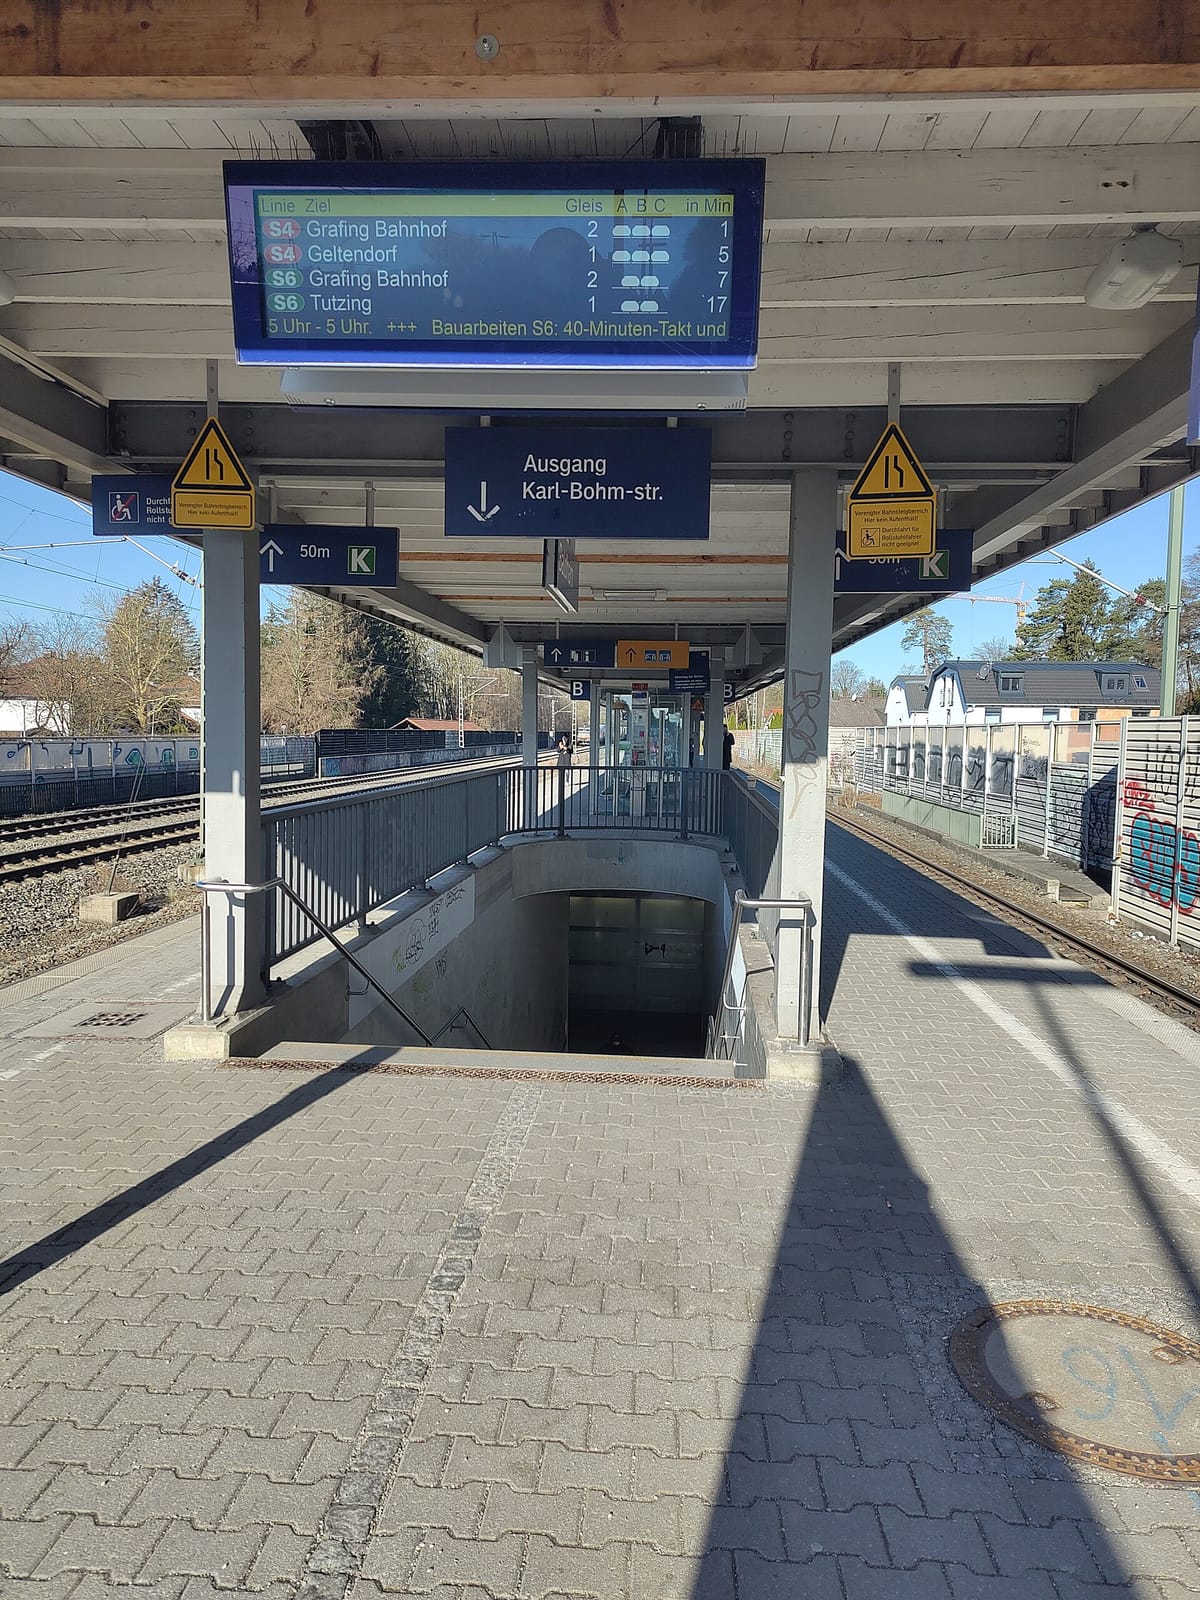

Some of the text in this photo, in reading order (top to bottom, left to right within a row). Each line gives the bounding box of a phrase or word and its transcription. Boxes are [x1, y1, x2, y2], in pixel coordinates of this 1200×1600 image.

[261, 198, 731, 213] Linie Ziel Gleis A B C in Min
[269, 219, 729, 241] S4 Grafing Bahnhof 2 1
[271, 245, 729, 263] S4 Geltendorf 1 5
[272, 270, 729, 291] S6 Grafing Bahnhof 2 7
[273, 294, 728, 315] S6 Tutzing 1 17
[268, 318, 278, 334] 5
[283, 318, 311, 334] Uhr
[326, 319, 336, 334] 5
[340, 318, 372, 334] Uhr.
[432, 319, 527, 336] Bauarbeiten
[532, 320, 558, 336] S6:
[563, 320, 692, 337] 40-Minuten-Takt
[696, 320, 727, 337] und
[523, 454, 607, 476] Ausgang
[522, 481, 663, 501] Karl-Bohm-str.
[146, 515, 165, 524] nicht
[300, 544, 371, 573] 50m K
[923, 552, 944, 577] K
[572, 681, 583, 696] B
[723, 683, 733, 698] B
